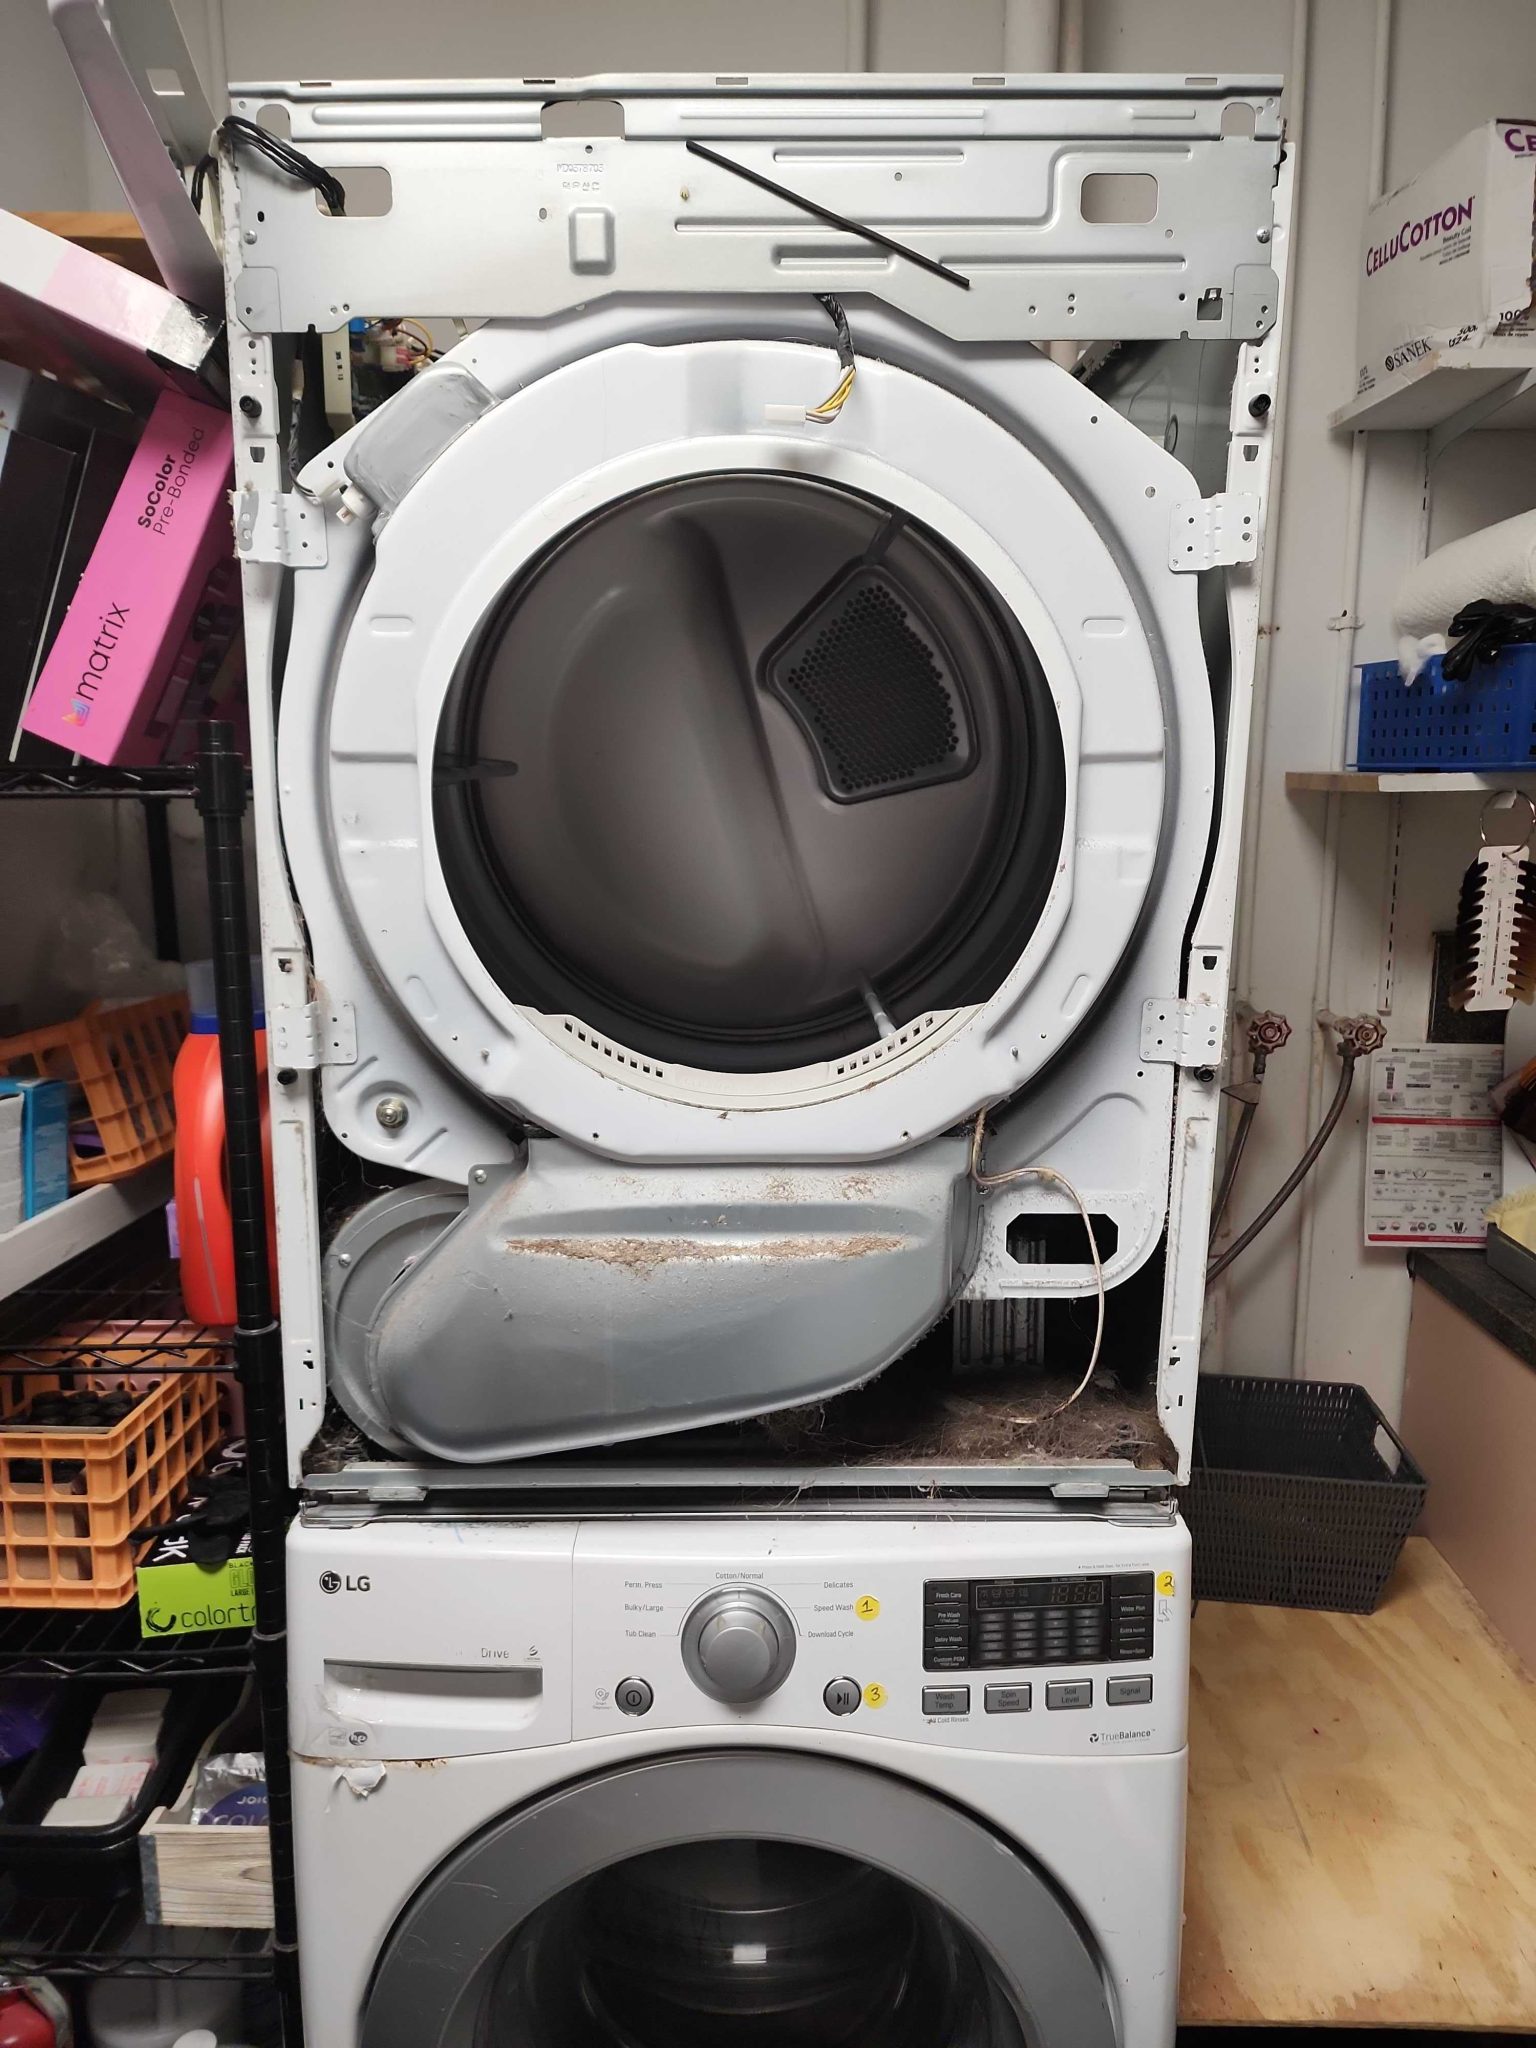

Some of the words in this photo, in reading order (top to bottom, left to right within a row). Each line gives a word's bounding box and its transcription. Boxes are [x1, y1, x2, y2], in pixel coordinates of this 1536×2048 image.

[1394, 340, 1432, 368] SANEK
[152, 427, 205, 535] Pre-Bonded
[137, 454, 176, 529] SoColor
[75, 601, 130, 701] matrix
[715, 1572, 764, 1580] Cotton/Normal
[345, 1575, 371, 1592] LG
[823, 1581, 854, 1589] Delicates
[624, 1604, 664, 1612] Bulky/Large
[813, 1604, 834, 1612] Speed
[807, 1630, 837, 1638] Download
[838, 1630, 854, 1638] Cycle
[870, 1686, 881, 1702] 3
[1001, 1690, 1017, 1699] Spin
[1064, 1687, 1077, 1695] Soil
[1119, 1686, 1141, 1696] Signal
[935, 1693, 955, 1701] Wash
[1061, 1696, 1080, 1704] Level
[935, 1701, 955, 1710] Temp
[998, 1699, 1020, 1708] Speed
[1100, 1730, 1151, 1741] TrueBalance
